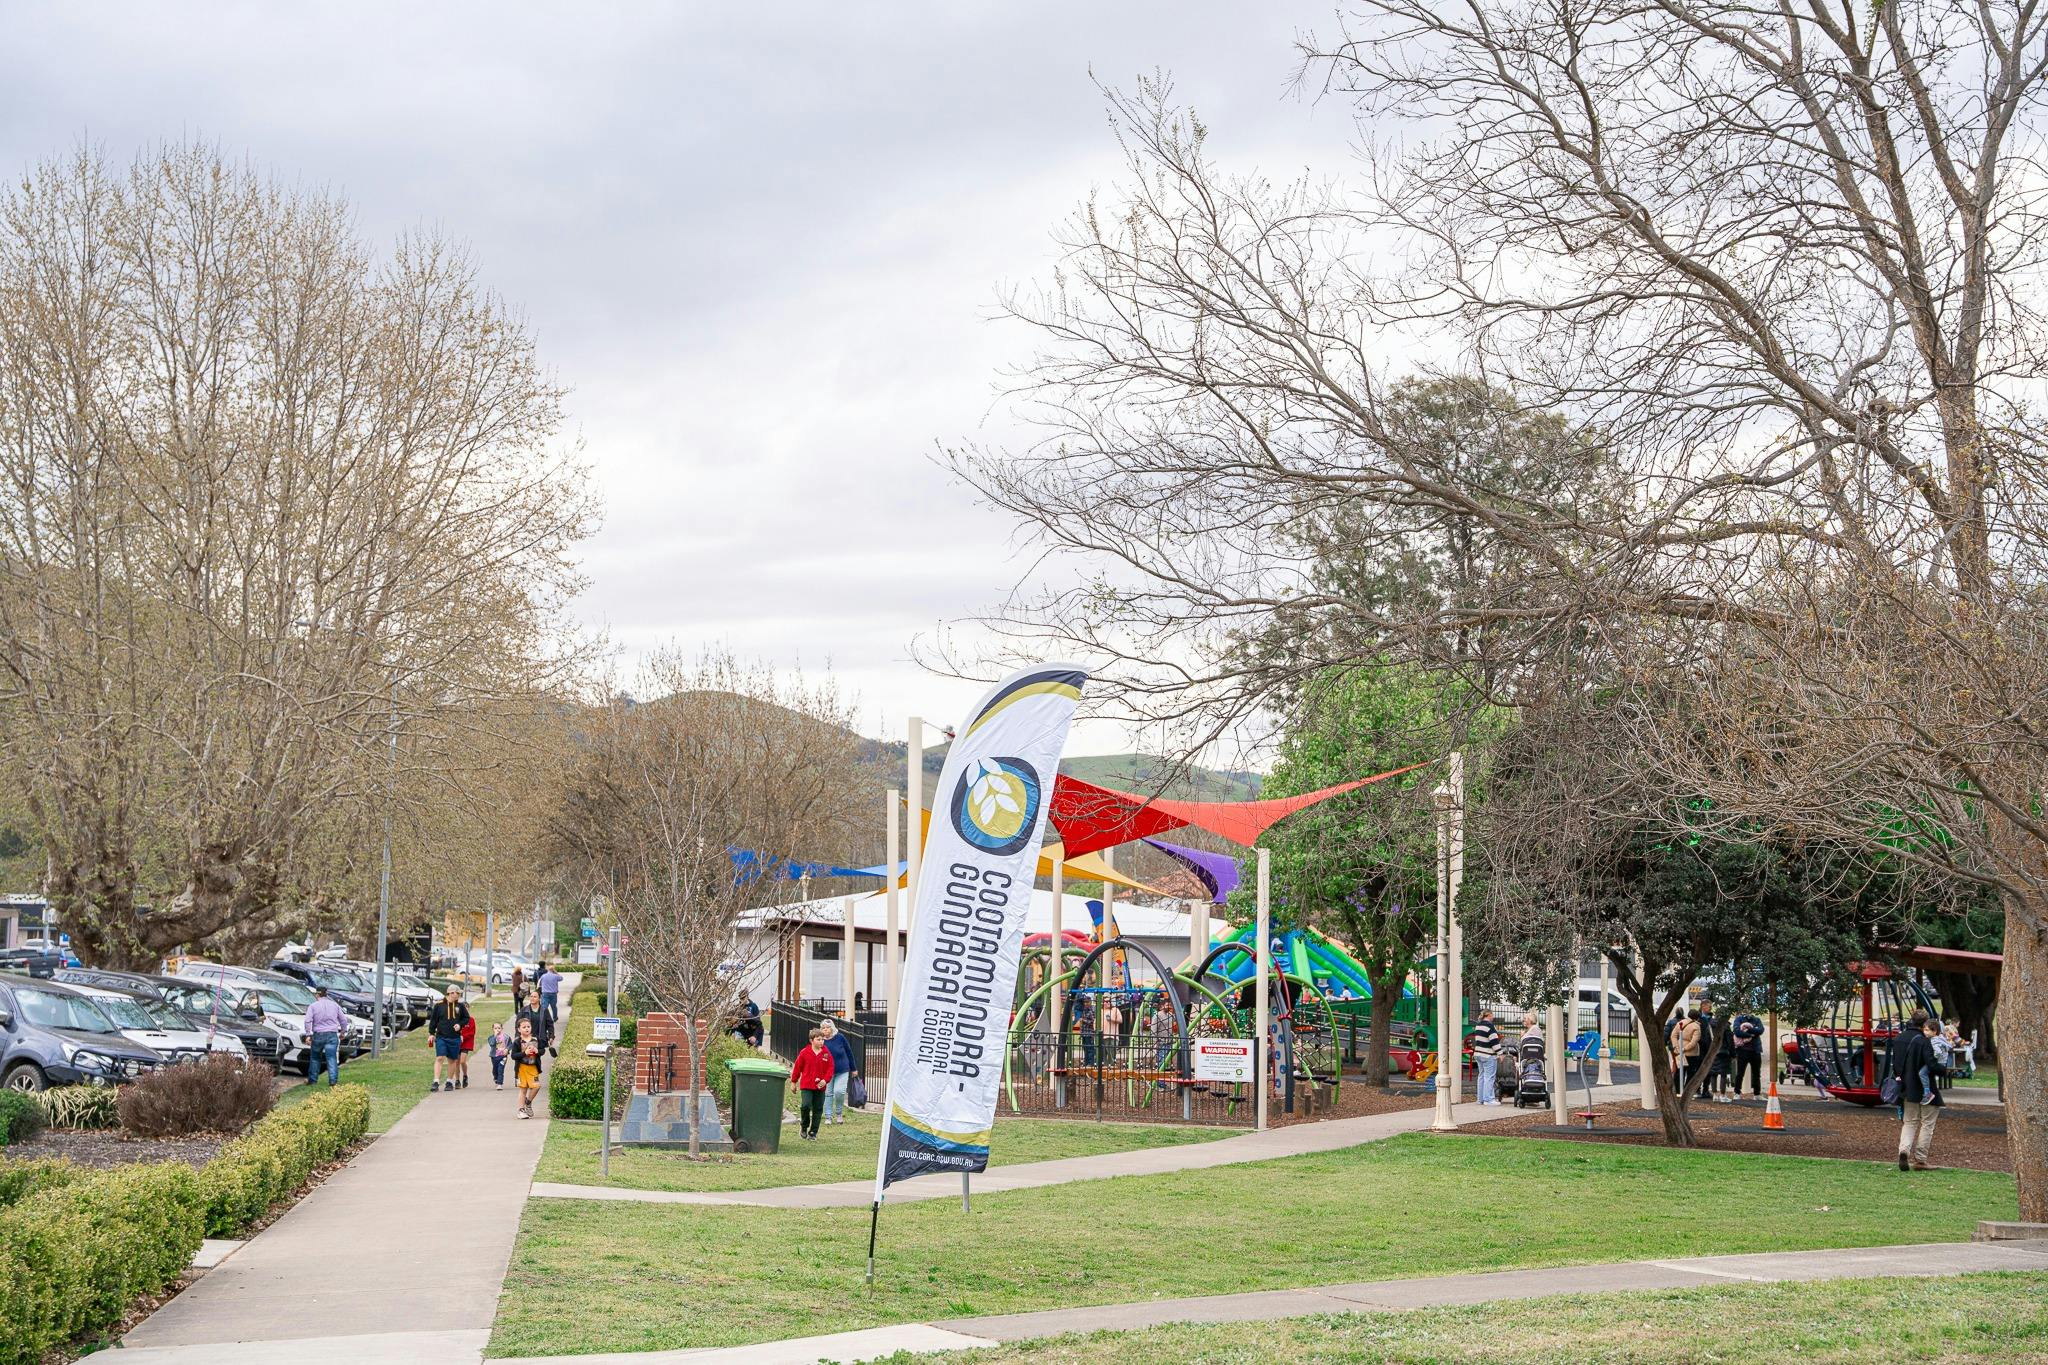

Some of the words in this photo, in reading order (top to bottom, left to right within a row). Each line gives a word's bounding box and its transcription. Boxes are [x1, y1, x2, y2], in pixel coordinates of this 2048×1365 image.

[927, 862, 980, 1004] GUNDAGAI
[950, 870, 1012, 1092] COOTAMUNDRA-
[916, 1008, 939, 1065] COUNCIL
[932, 1010, 956, 1075] REGIONAL
